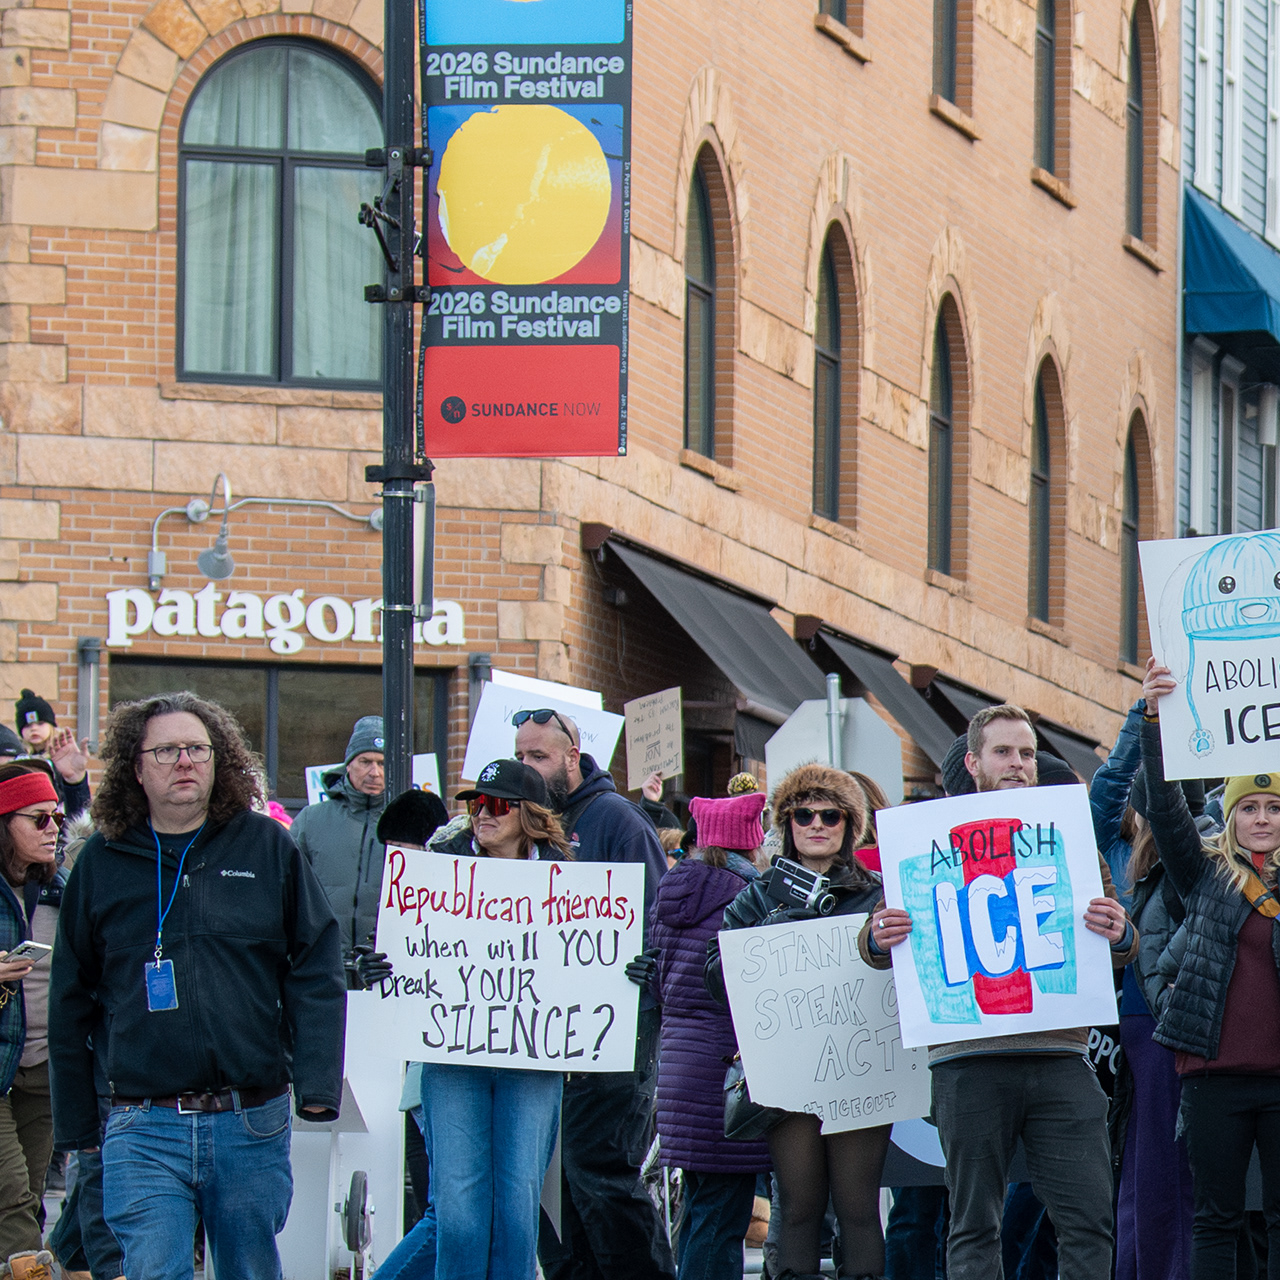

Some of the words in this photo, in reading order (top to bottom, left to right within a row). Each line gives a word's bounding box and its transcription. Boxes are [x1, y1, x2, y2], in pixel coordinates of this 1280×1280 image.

[426, 52, 489, 76] 2026
[493, 51, 625, 75] Sundance
[444, 75, 499, 99] Film
[504, 75, 604, 98] Festival
[428, 291, 486, 315] 2026
[490, 290, 622, 314] Sundance
[442, 315, 496, 338] Film
[501, 315, 601, 338] Festival
[471, 403, 559, 417] SUNDANCE
[563, 402, 601, 416] NOW
[930, 821, 1057, 876] ABOLISH
[227, 870, 256, 879] Columbia
[385, 850, 533, 926] Republican
[541, 863, 635, 930] friends,
[405, 923, 469, 959] when
[487, 931, 539, 962] will
[558, 928, 620, 967] YOU
[932, 865, 1066, 988] ICE
[458, 964, 541, 1005] YOUR
[754, 978, 867, 1041] SPEAK
[422, 1003, 616, 1061] SILENCE?
[803, 1090, 897, 1123] #ICEOUT
